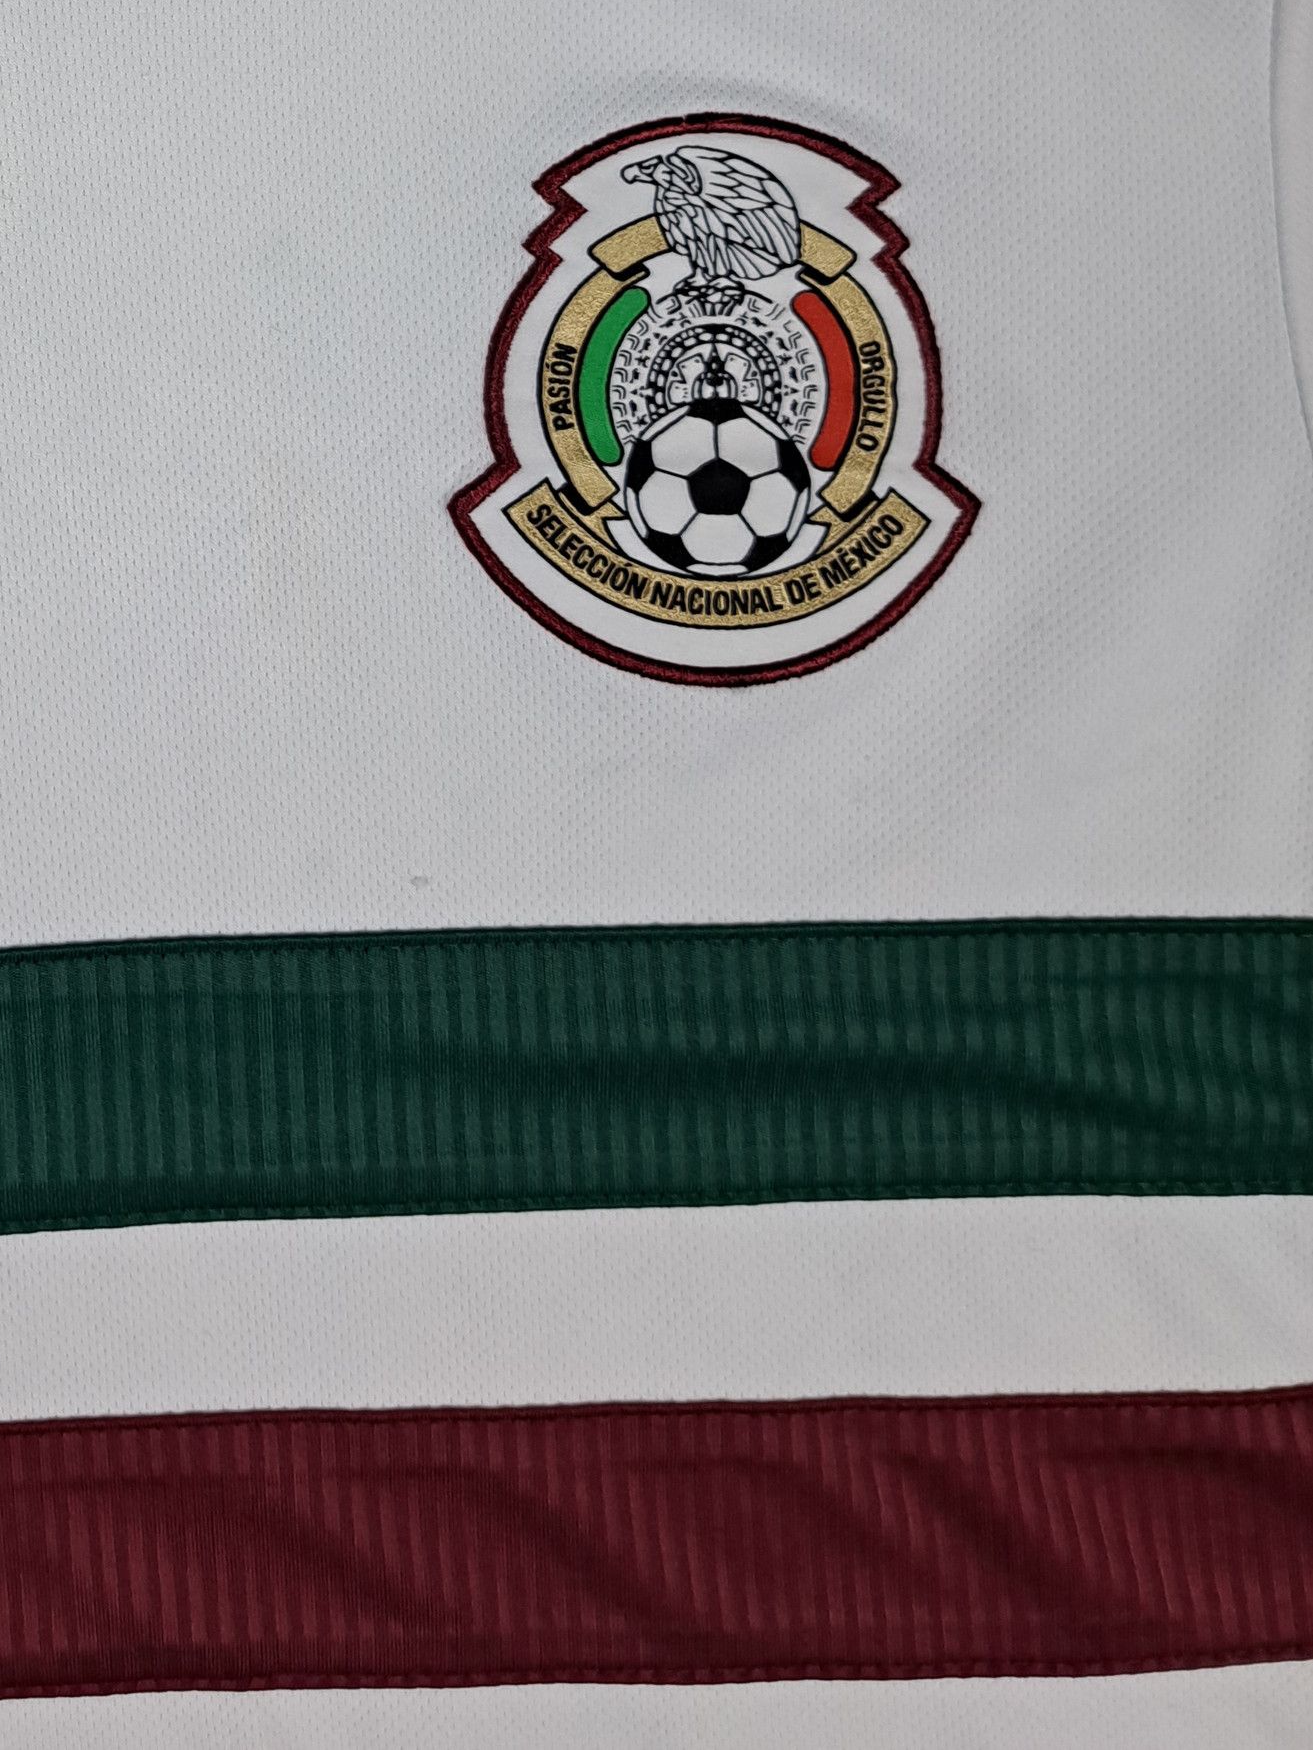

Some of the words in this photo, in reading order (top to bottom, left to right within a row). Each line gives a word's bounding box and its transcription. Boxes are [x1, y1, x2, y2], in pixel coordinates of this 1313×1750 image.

[545, 342, 578, 432] PASIÓN
[856, 340, 886, 452] ORGULLO
[526, 503, 648, 600] SELECCIÓN
[649, 580, 784, 616] NACIONAL
[783, 572, 822, 605] DE
[817, 513, 904, 589] MÉXICO
